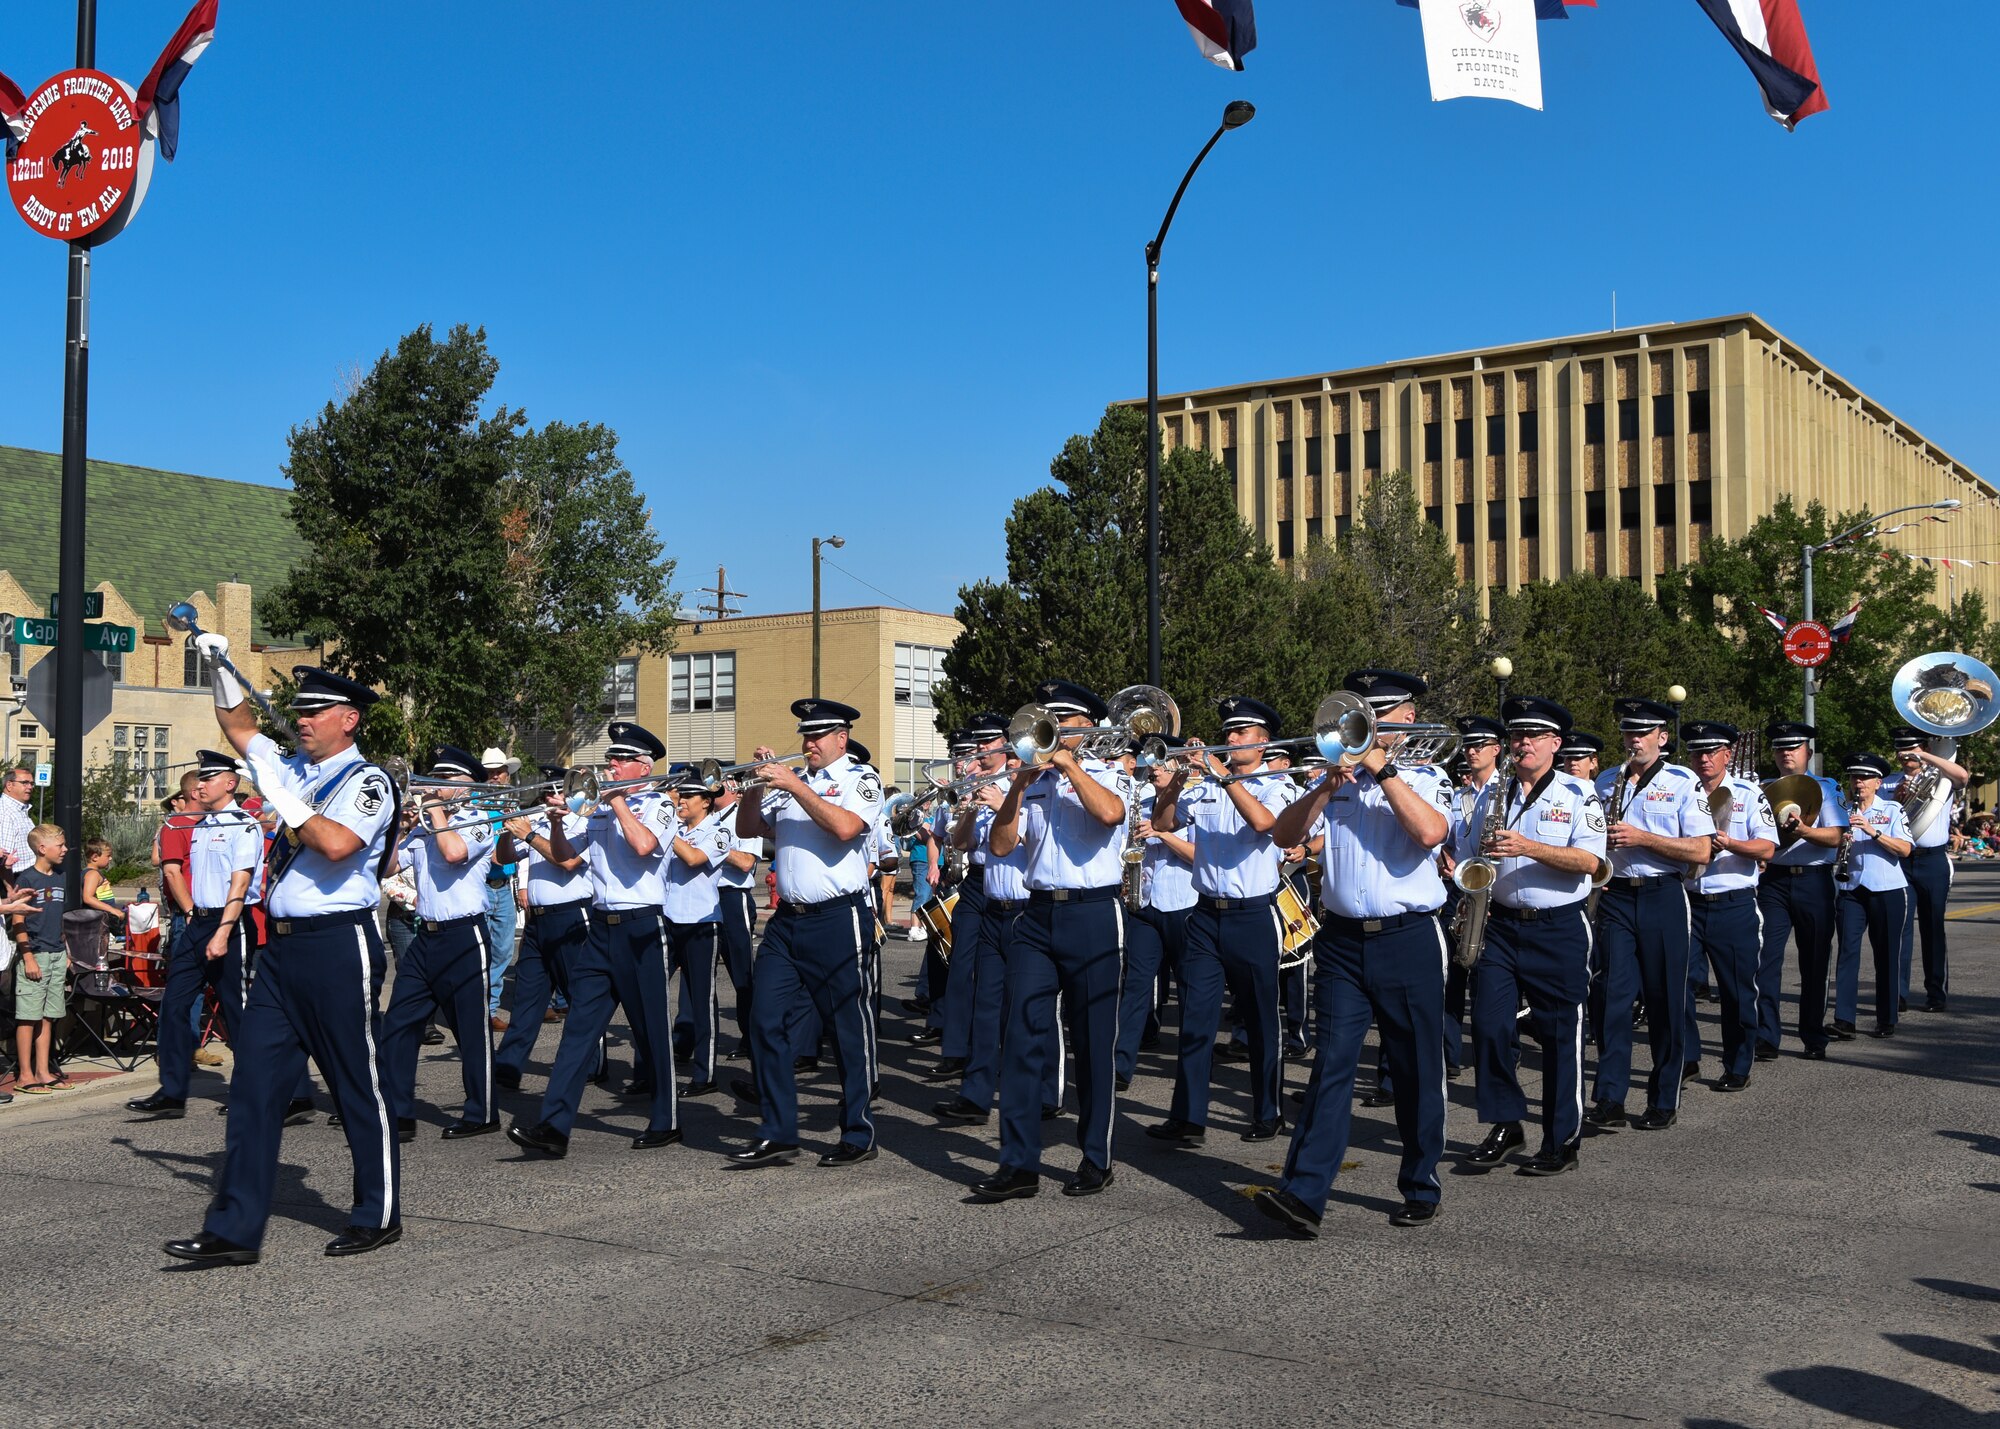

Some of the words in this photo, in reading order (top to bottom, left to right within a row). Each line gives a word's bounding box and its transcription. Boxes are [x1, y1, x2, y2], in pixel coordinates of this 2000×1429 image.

[1451, 48, 1520, 63] CHEYENNE
[1456, 62, 1519, 78] FRONTIER
[1473, 77, 1505, 89] DAYS
[63, 76, 114, 105] FRONTIER
[109, 95, 132, 131] DAYS
[13, 156, 43, 182] 122nd
[101, 146, 133, 171] 2018
[22, 194, 57, 230] DADDY
[58, 212, 73, 232] OF
[77, 202, 100, 228] 'EM
[98, 185, 122, 213] ALL
[85, 596, 96, 616] St
[99, 626, 129, 647] Ave
